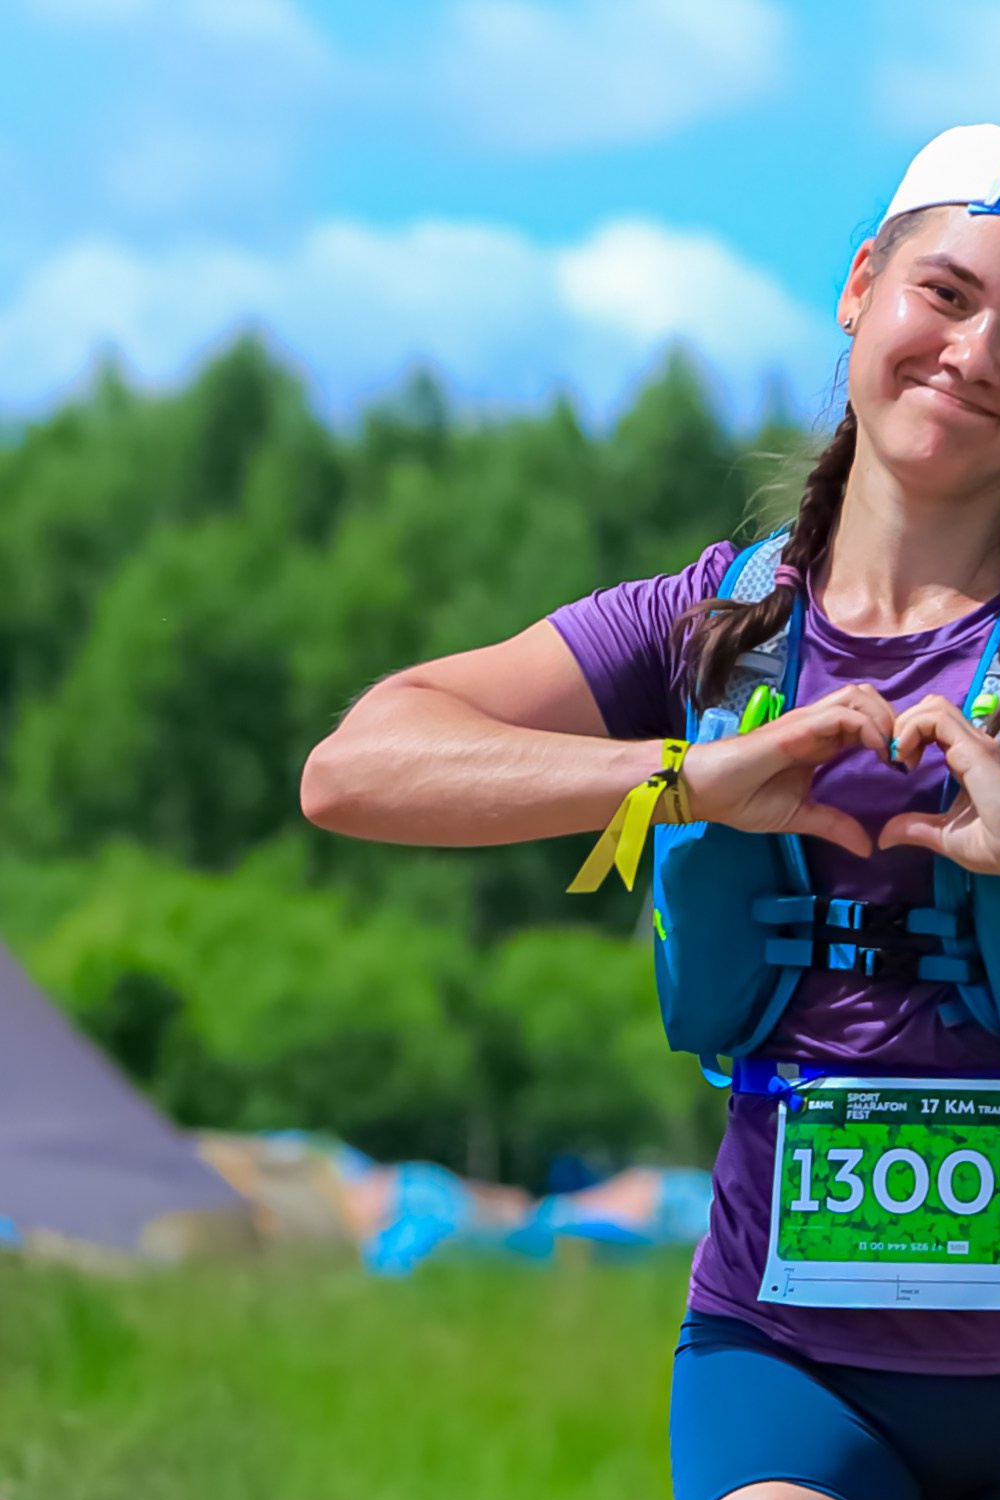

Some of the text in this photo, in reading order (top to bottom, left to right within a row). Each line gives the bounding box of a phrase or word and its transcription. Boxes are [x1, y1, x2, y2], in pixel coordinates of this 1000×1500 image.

[847, 1093, 880, 1102] SPORT
[921, 1099, 940, 1114] 17
[945, 1099, 975, 1114] KM
[846, 1110, 870, 1120] FEST
